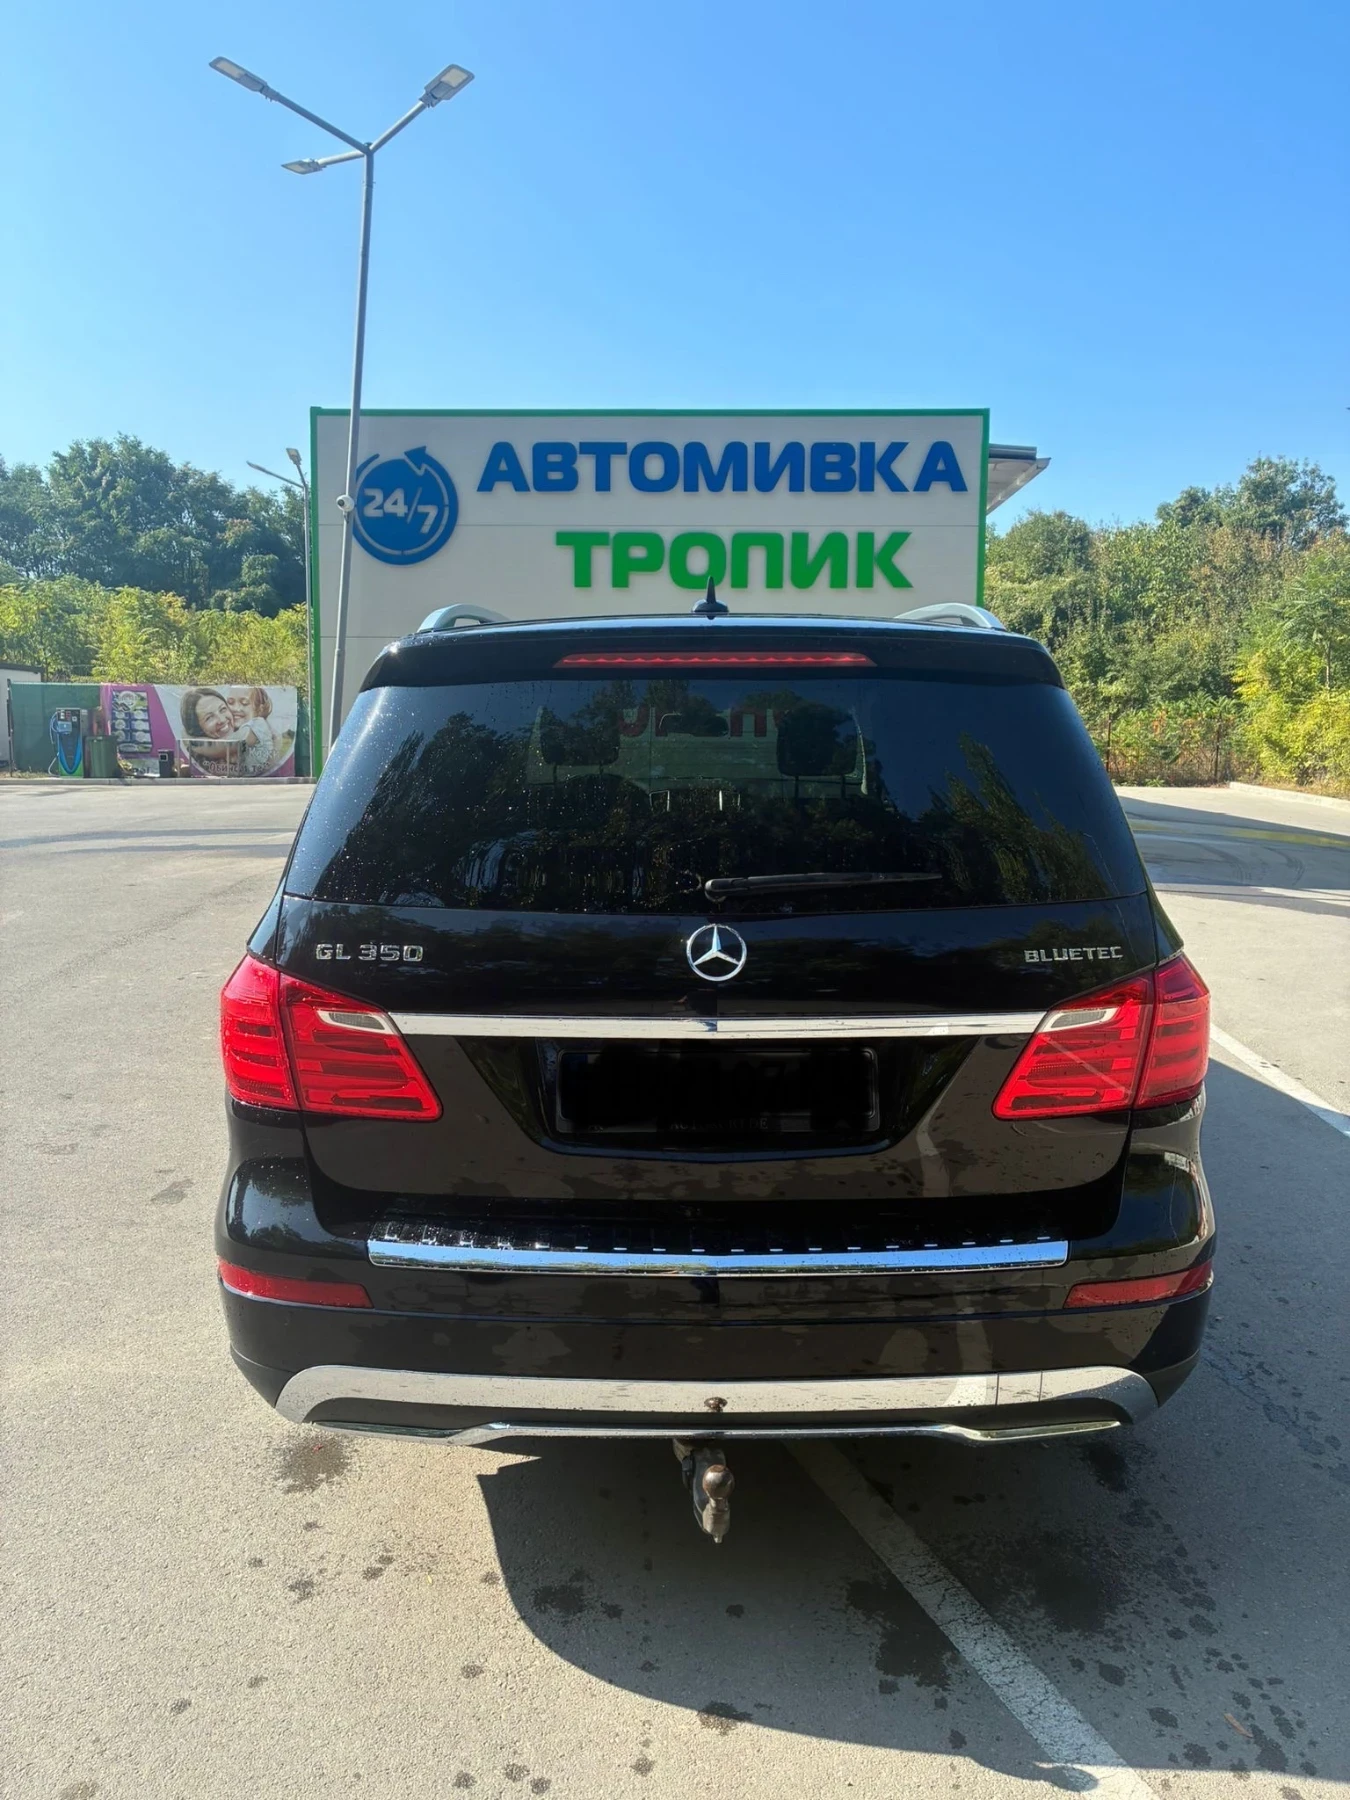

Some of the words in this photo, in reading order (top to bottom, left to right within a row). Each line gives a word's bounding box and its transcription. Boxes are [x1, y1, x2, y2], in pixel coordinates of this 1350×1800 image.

[477, 441, 968, 493] АВТОМИВКА
[363, 487, 439, 535] 24/7
[556, 530, 913, 589] ТРОПИК
[316, 943, 351, 960] GL
[358, 943, 424, 962] 350
[1024, 946, 1123, 962] BLUETEC
